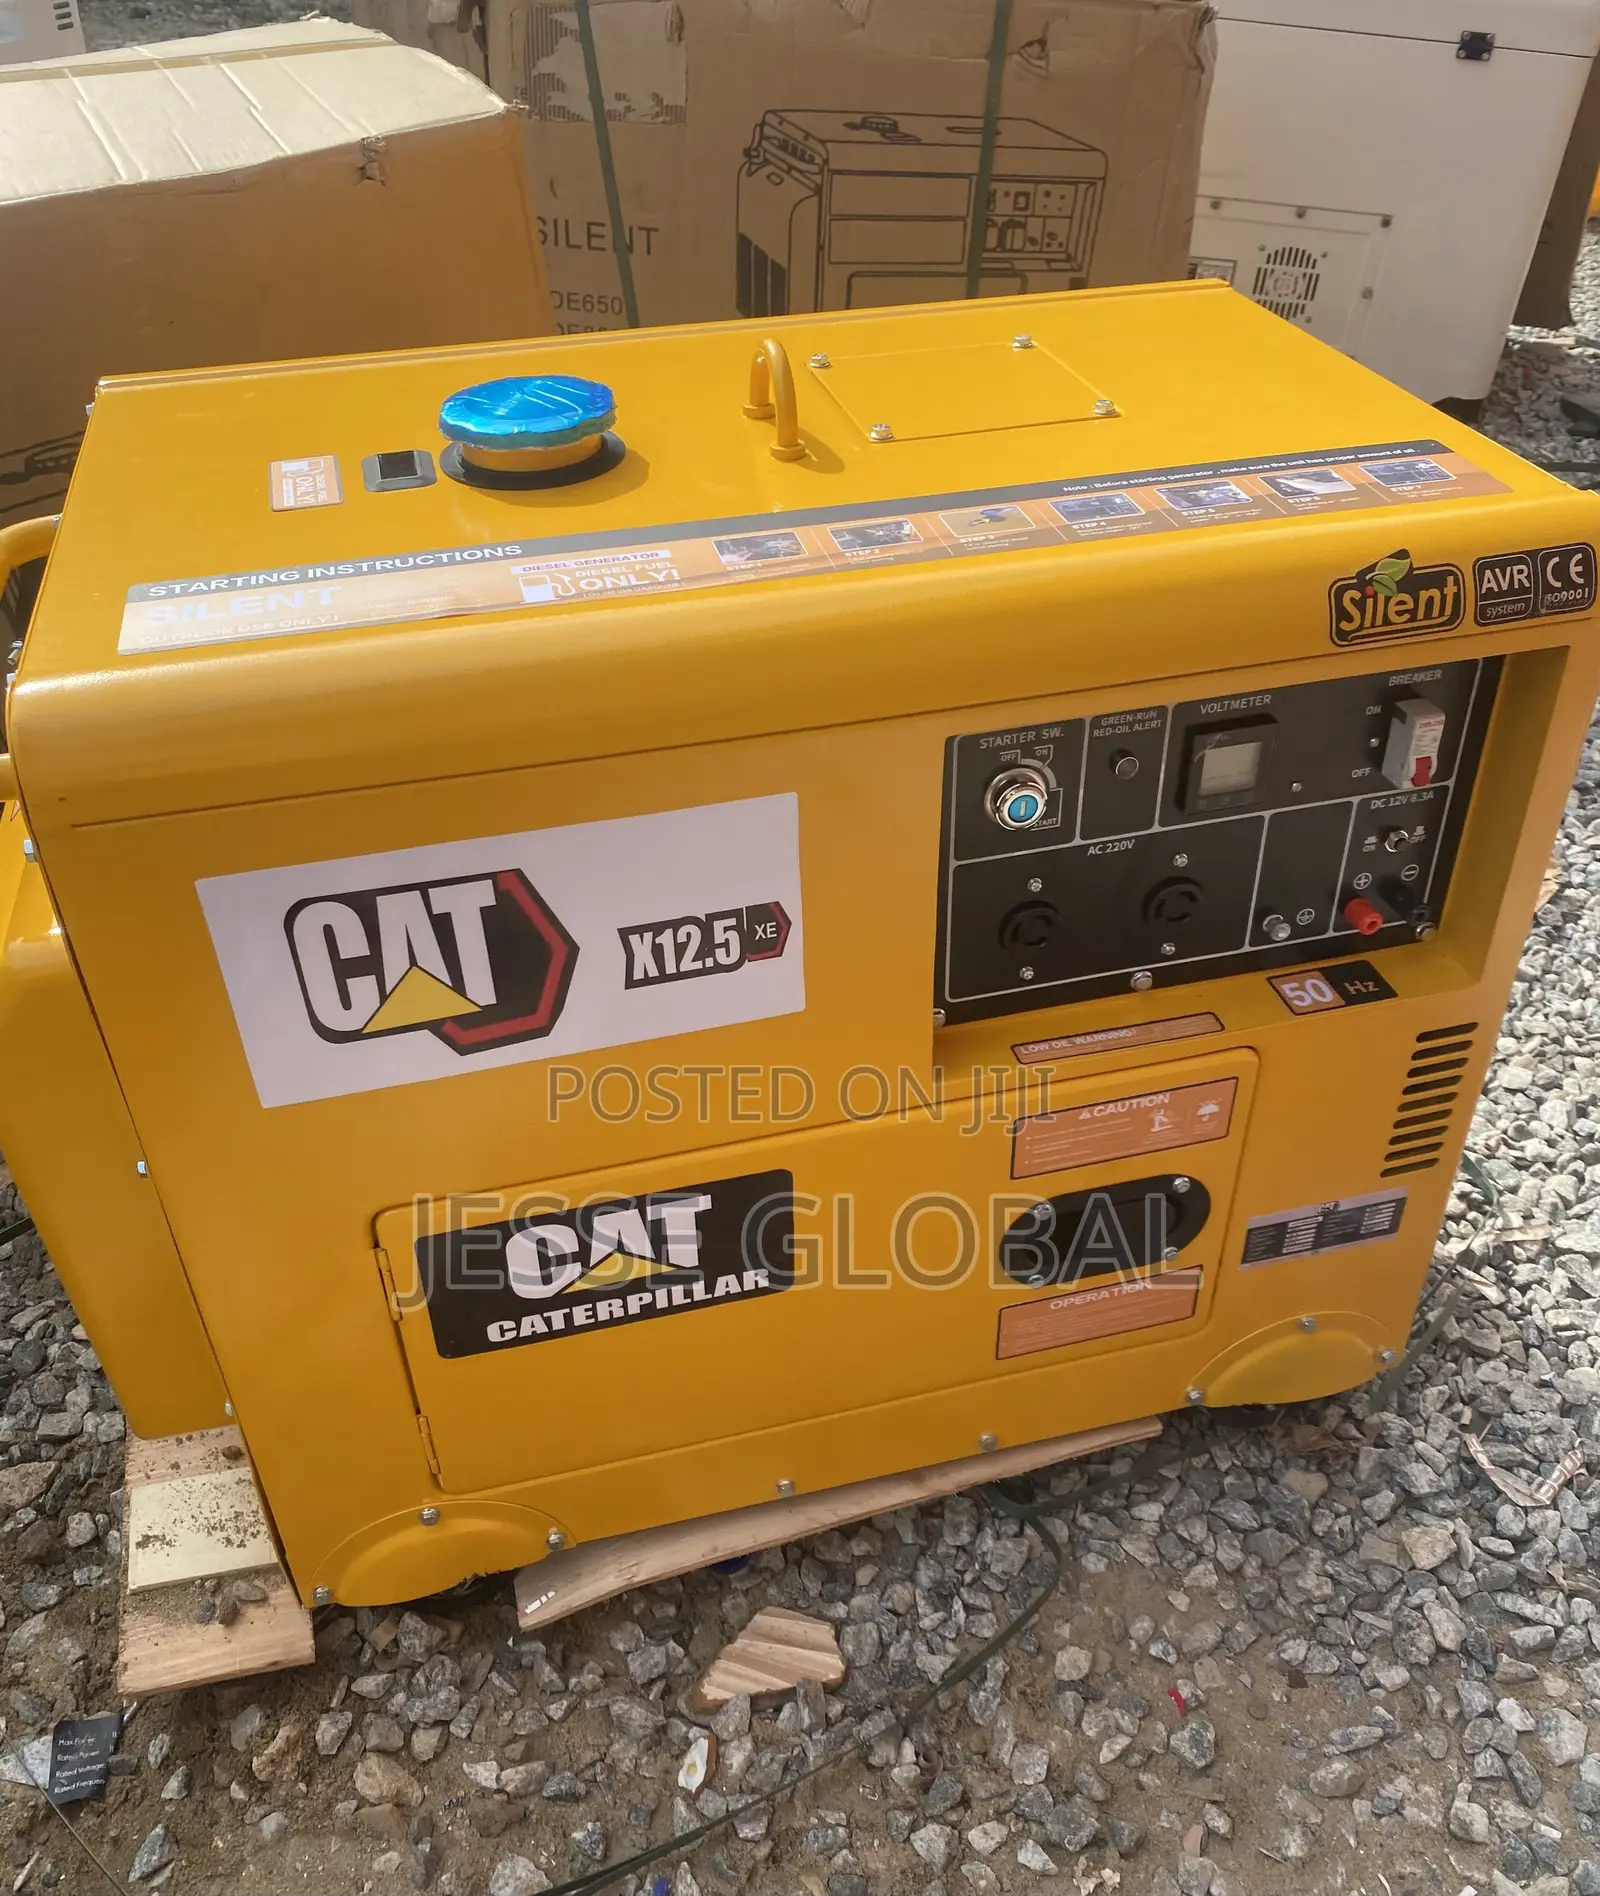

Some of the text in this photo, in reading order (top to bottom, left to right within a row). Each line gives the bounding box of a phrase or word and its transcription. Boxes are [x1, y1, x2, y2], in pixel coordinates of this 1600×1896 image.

[536, 215, 660, 256] SILENT
[1094, 480, 1128, 488] Before
[1129, 476, 1167, 484] starting
[1168, 470, 1213, 480] generator
[1326, 454, 1356, 463] proper
[1357, 451, 1391, 459] amount
[149, 544, 523, 597] STARTING INSTRUCTIONS
[522, 552, 660, 573] DIESEL GENERATOR
[575, 561, 677, 578] DIESEL FUEL
[579, 568, 681, 591] ONLY!
[1481, 564, 1531, 594] AVR
[145, 585, 343, 627] SILENT
[1338, 575, 1457, 632] Silent
[1486, 601, 1526, 618] system
[238, 622, 276, 634] USE
[1388, 669, 1443, 687] BREAKER
[1200, 694, 1272, 715] VOLTMETER
[1366, 705, 1382, 715] ON
[1093, 719, 1162, 738] RED-OIL ALERT
[1101, 710, 1158, 727] GREEN-RUN
[979, 727, 1065, 749] STARTER SW.
[1001, 752, 1018, 763] OFF
[1035, 746, 1048, 757] ON
[1352, 767, 1372, 778] OFF
[1370, 791, 1434, 809] DC 12V 8.3A
[1034, 817, 1058, 827] START
[1087, 839, 1135, 857] AC 220V
[754, 921, 778, 941] XE
[293, 879, 497, 1032] CAT
[629, 910, 742, 983] X12.5
[1280, 977, 1334, 1007] 50
[1020, 1042, 1049, 1054] LOW
[1052, 1039, 1073, 1050] OIL
[1093, 1093, 1171, 1118] CAUTION
[505, 1194, 712, 1299] CAT
[1050, 1279, 1153, 1310] OPERATION
[486, 1268, 770, 1344] CATERPILLAR
[56, 1767, 77, 1777] Rated
[54, 1783, 75, 1794] Rated
